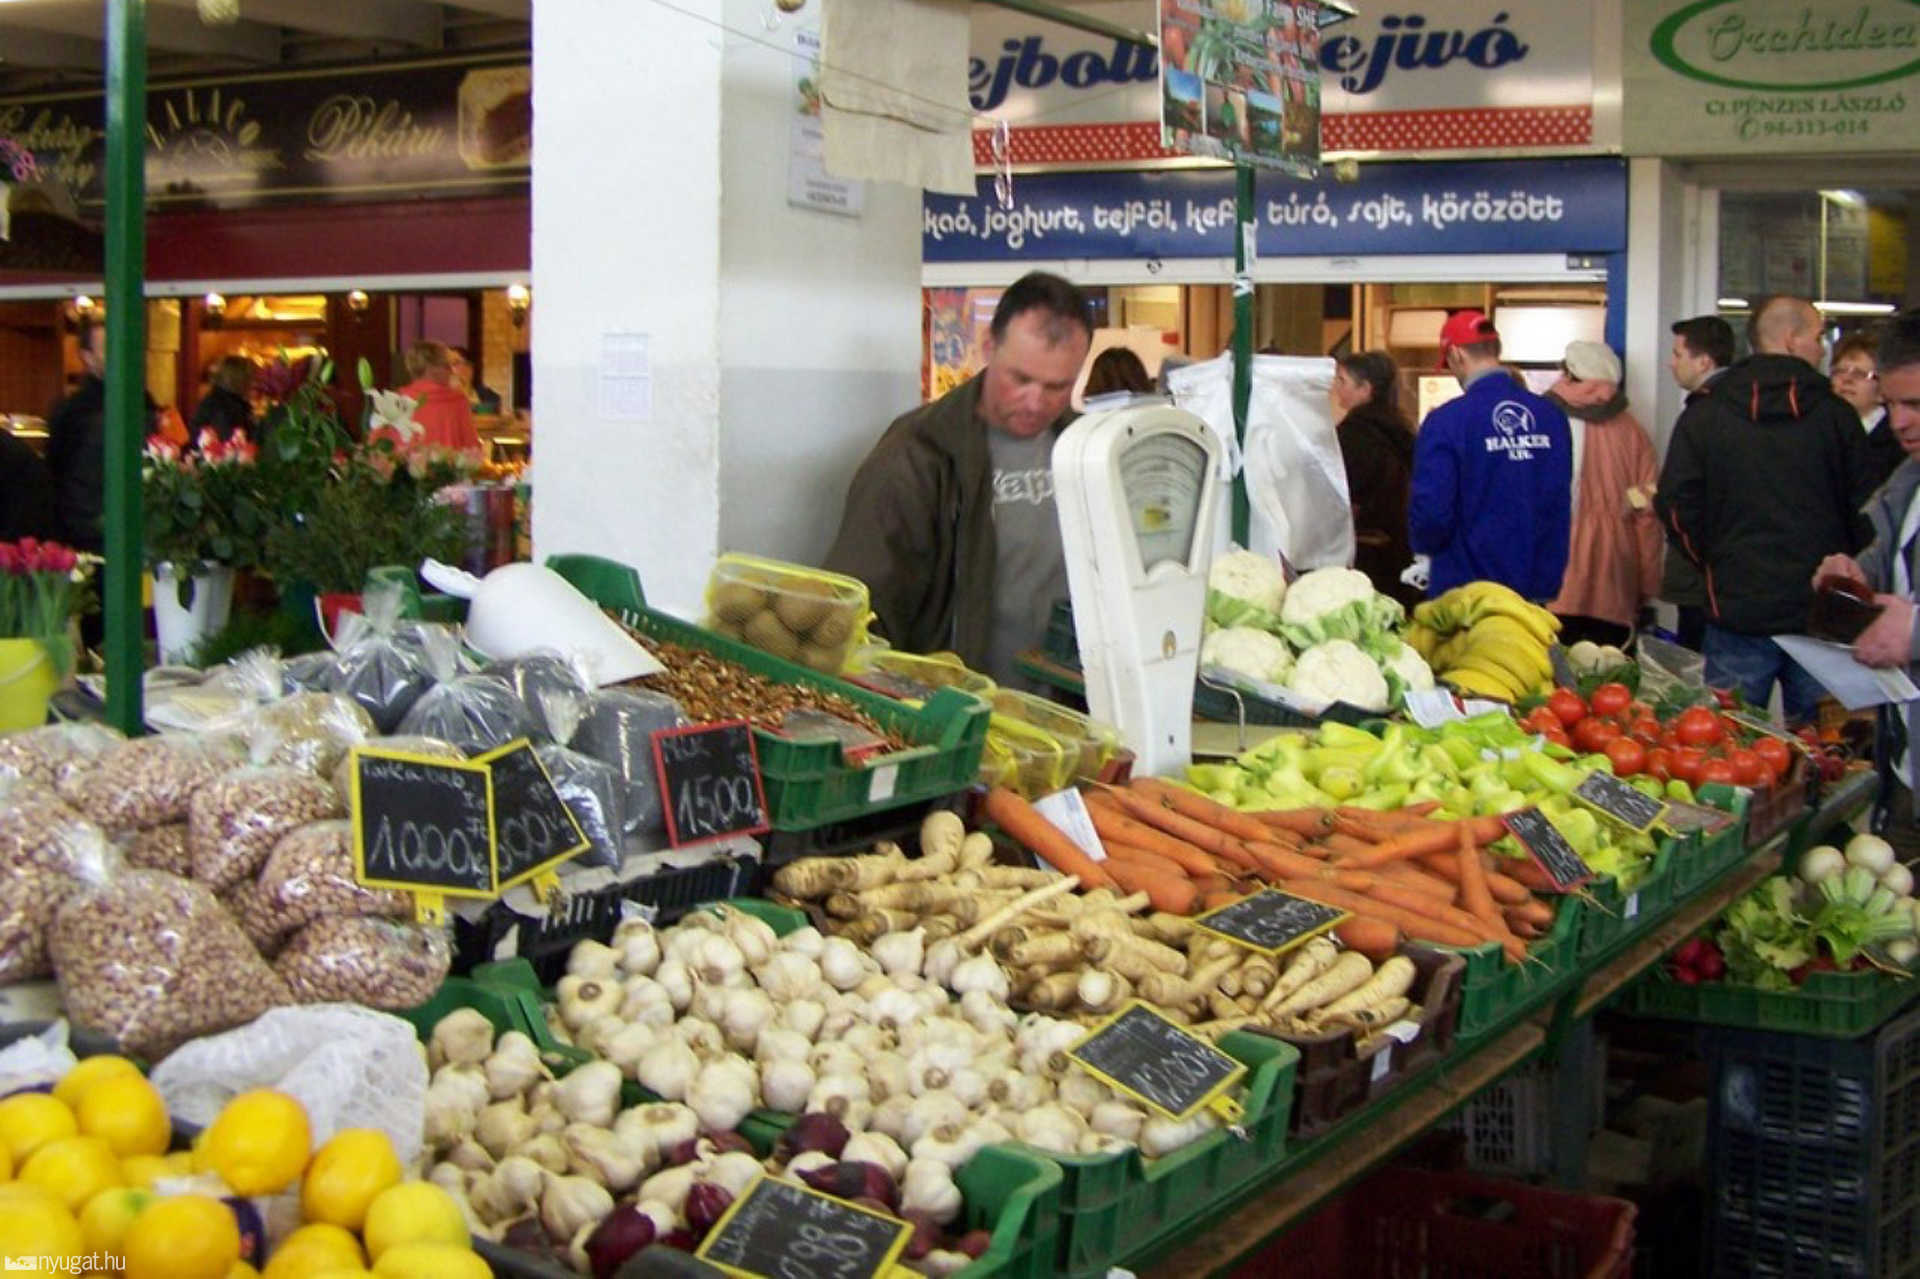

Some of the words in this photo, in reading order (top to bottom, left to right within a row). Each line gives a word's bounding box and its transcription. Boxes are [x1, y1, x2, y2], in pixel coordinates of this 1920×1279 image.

[981, 203, 1085, 249] joghurt,
[1093, 199, 1178, 237] tejföl,
[1267, 193, 1338, 228] túró,
[1347, 193, 1413, 230] sajt,
[1421, 191, 1564, 229] körözött
[367, 814, 471, 875] 1000
